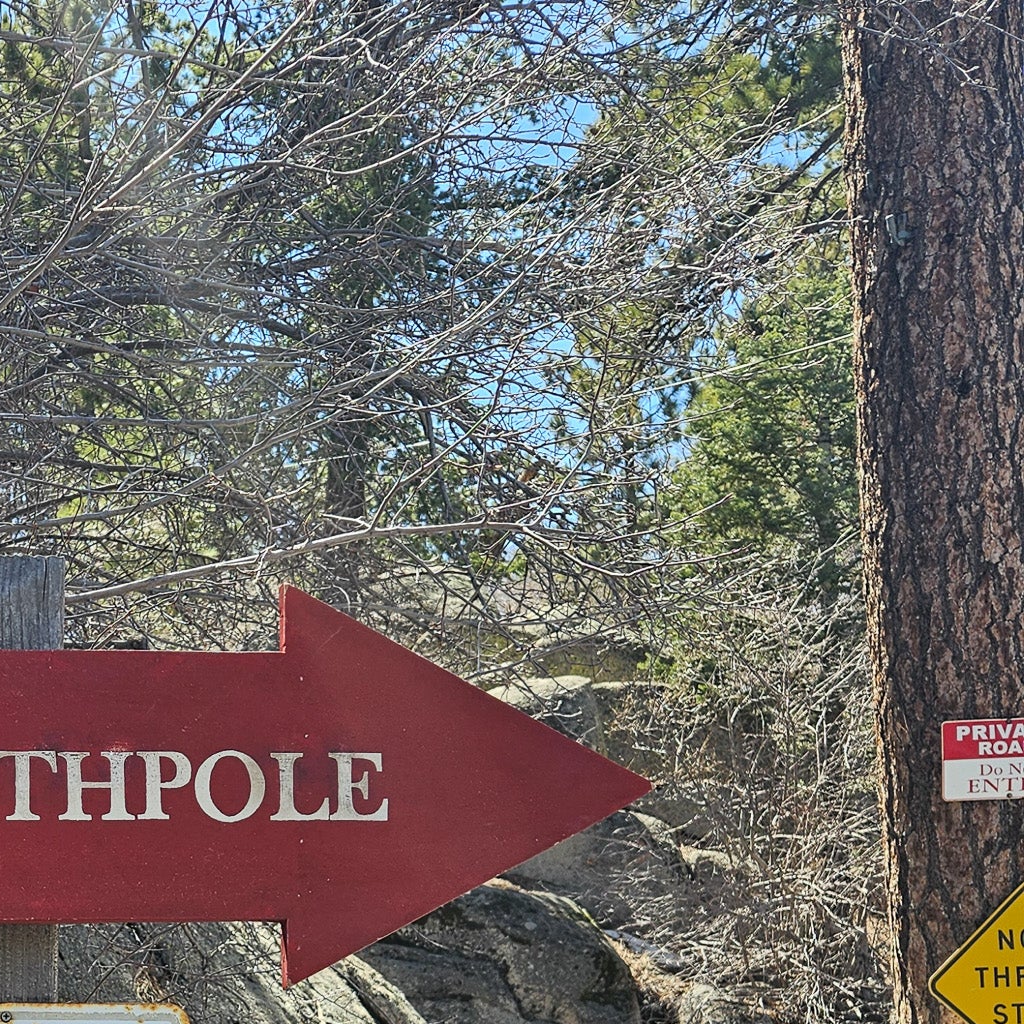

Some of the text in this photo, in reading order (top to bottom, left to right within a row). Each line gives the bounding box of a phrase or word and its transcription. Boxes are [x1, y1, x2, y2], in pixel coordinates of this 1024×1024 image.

[956, 723, 1024, 741] PRIVA
[978, 740, 1024, 755] ROA
[1009, 762, 1024, 775] N
